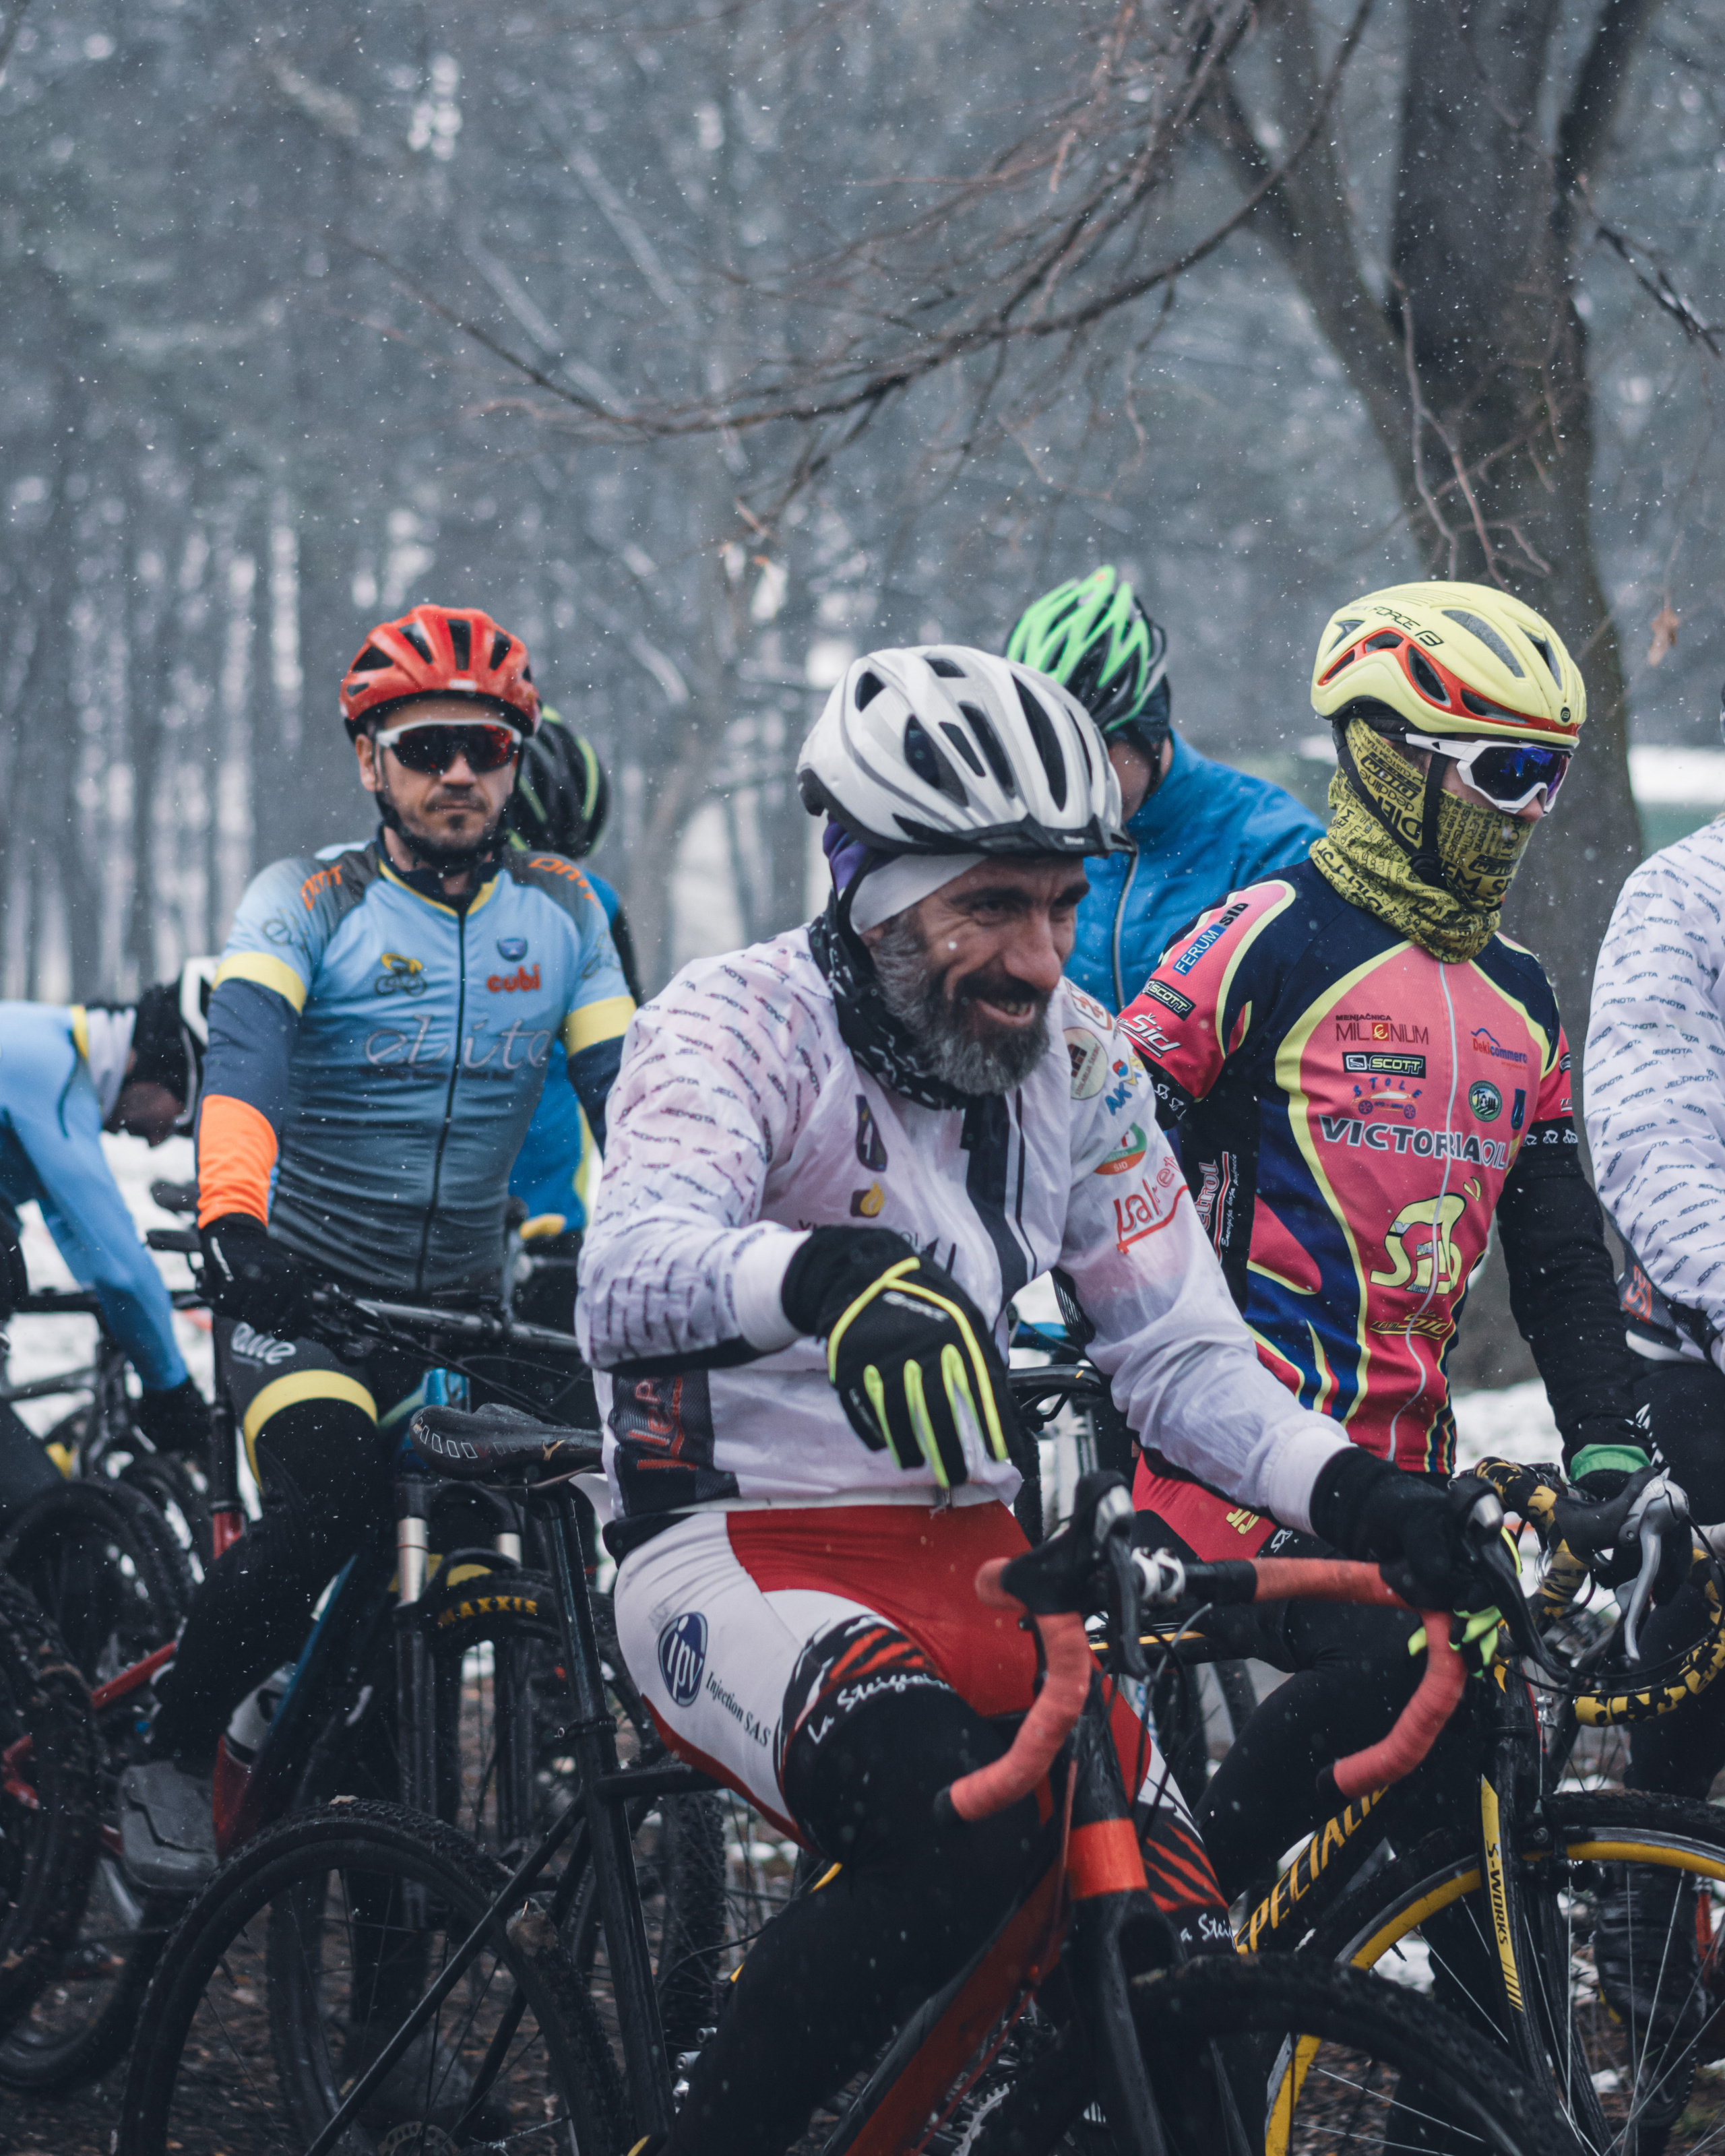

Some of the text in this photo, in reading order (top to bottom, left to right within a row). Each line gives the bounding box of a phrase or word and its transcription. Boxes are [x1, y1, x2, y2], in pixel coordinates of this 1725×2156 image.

[1368, 606, 1421, 630] FORCE
[1360, 769, 1414, 813] deadline
[1175, 929, 1219, 974] FERUM
[487, 963, 540, 993] cubi
[1150, 984, 1188, 1011] SCOTT
[1336, 1013, 1392, 1021] MENJAČNICA
[1372, 1058, 1420, 1071] SCOTT
[1353, 1077, 1423, 1100] STOLE
[1591, 1075, 1624, 1096] JEDNOTA
[1618, 1087, 1656, 1107] JEDNOTA
[660, 1106, 716, 1125] JEDNOTA
[1616, 1122, 1658, 1141] JEDNOTA
[1649, 1181, 1689, 1207] JEDNOTA
[1677, 1198, 1720, 1217] JEDNOTA
[1666, 1222, 1710, 1244] JEDNOTA
[667, 1615, 704, 1703] ipv
[705, 1671, 772, 1748] Injection SAS
[807, 1715, 836, 1744] La
[1486, 1840, 1509, 1945] S-WORKS
